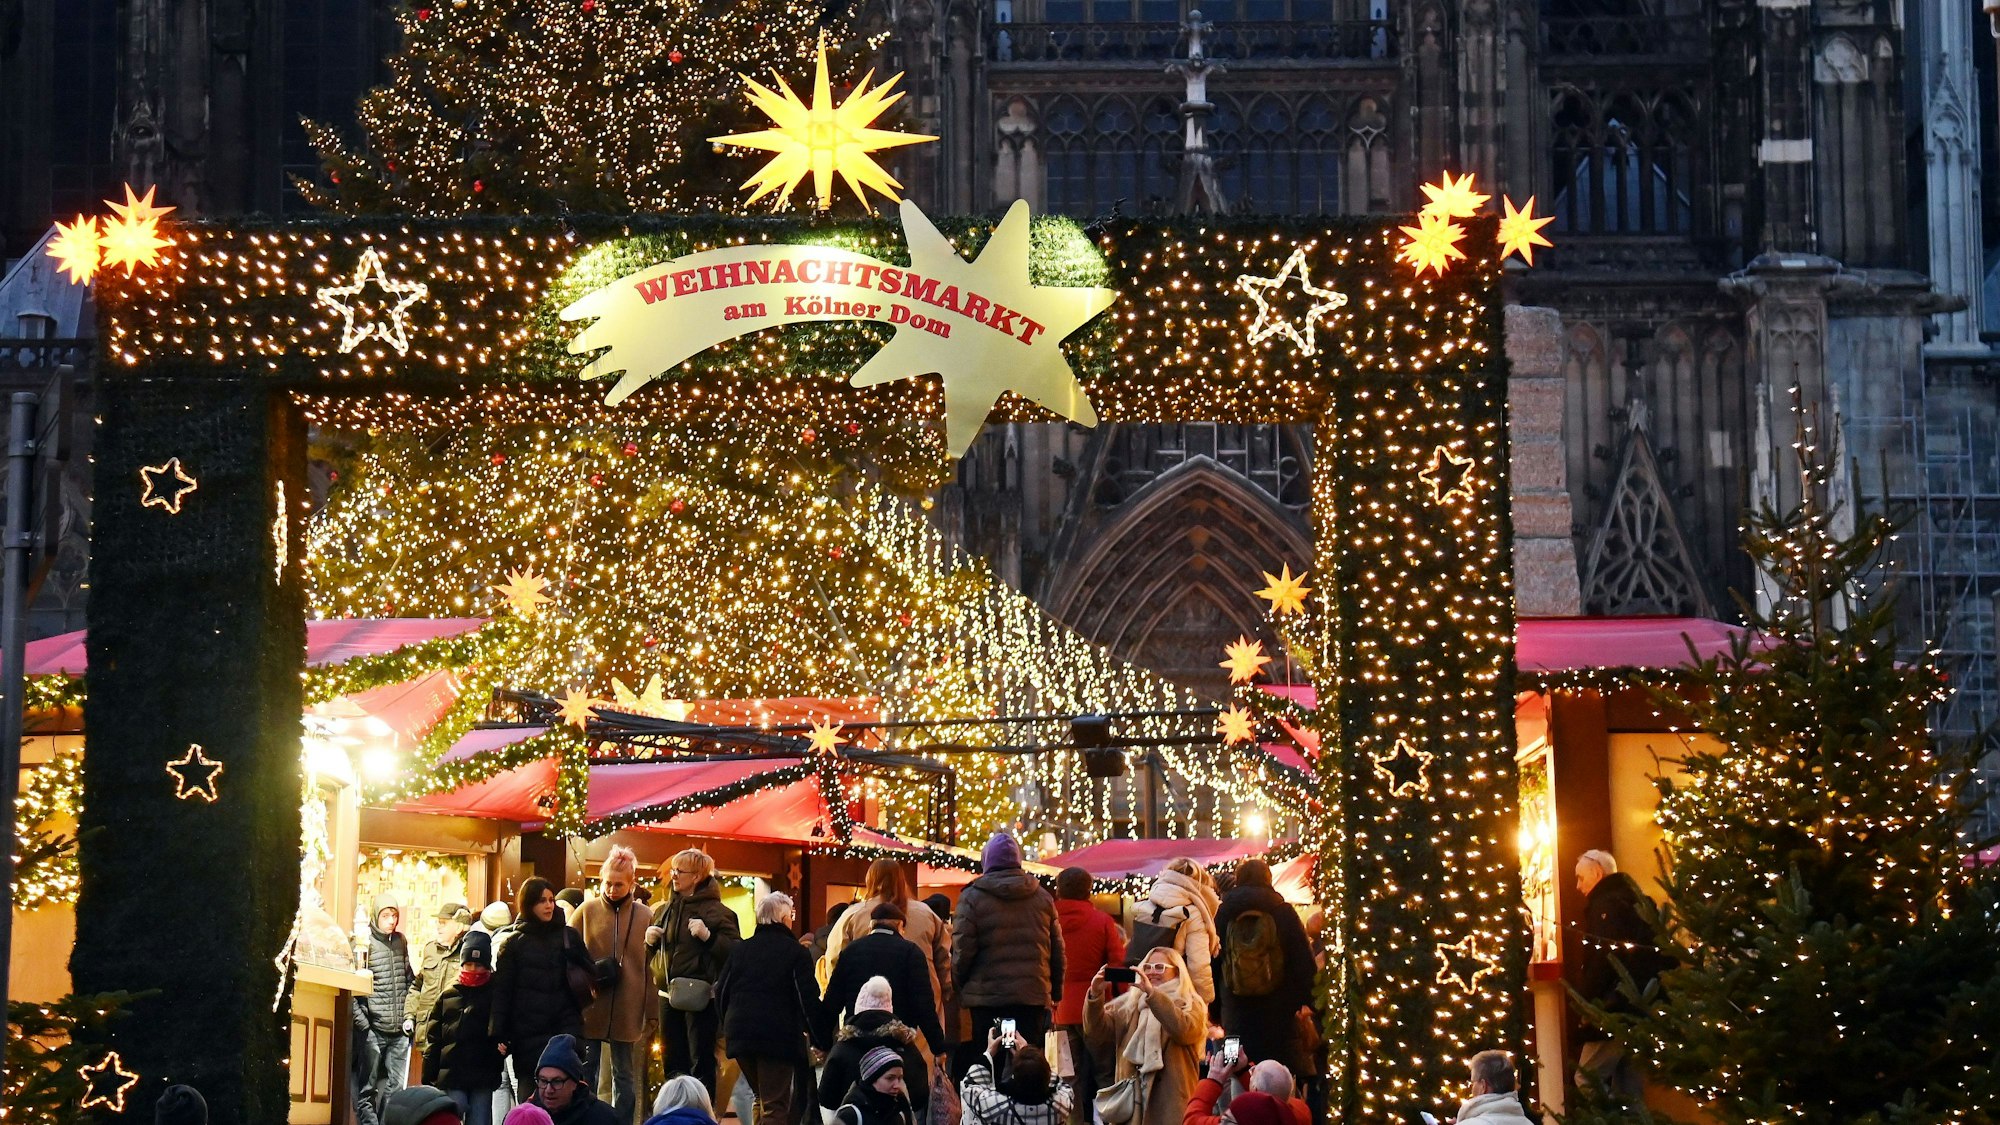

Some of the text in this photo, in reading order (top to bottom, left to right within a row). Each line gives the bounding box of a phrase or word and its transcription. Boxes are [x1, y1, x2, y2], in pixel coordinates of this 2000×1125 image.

[634, 259, 1046, 346] WEIHNACHTSMARKT
[723, 296, 952, 339] am Kölner Dom
